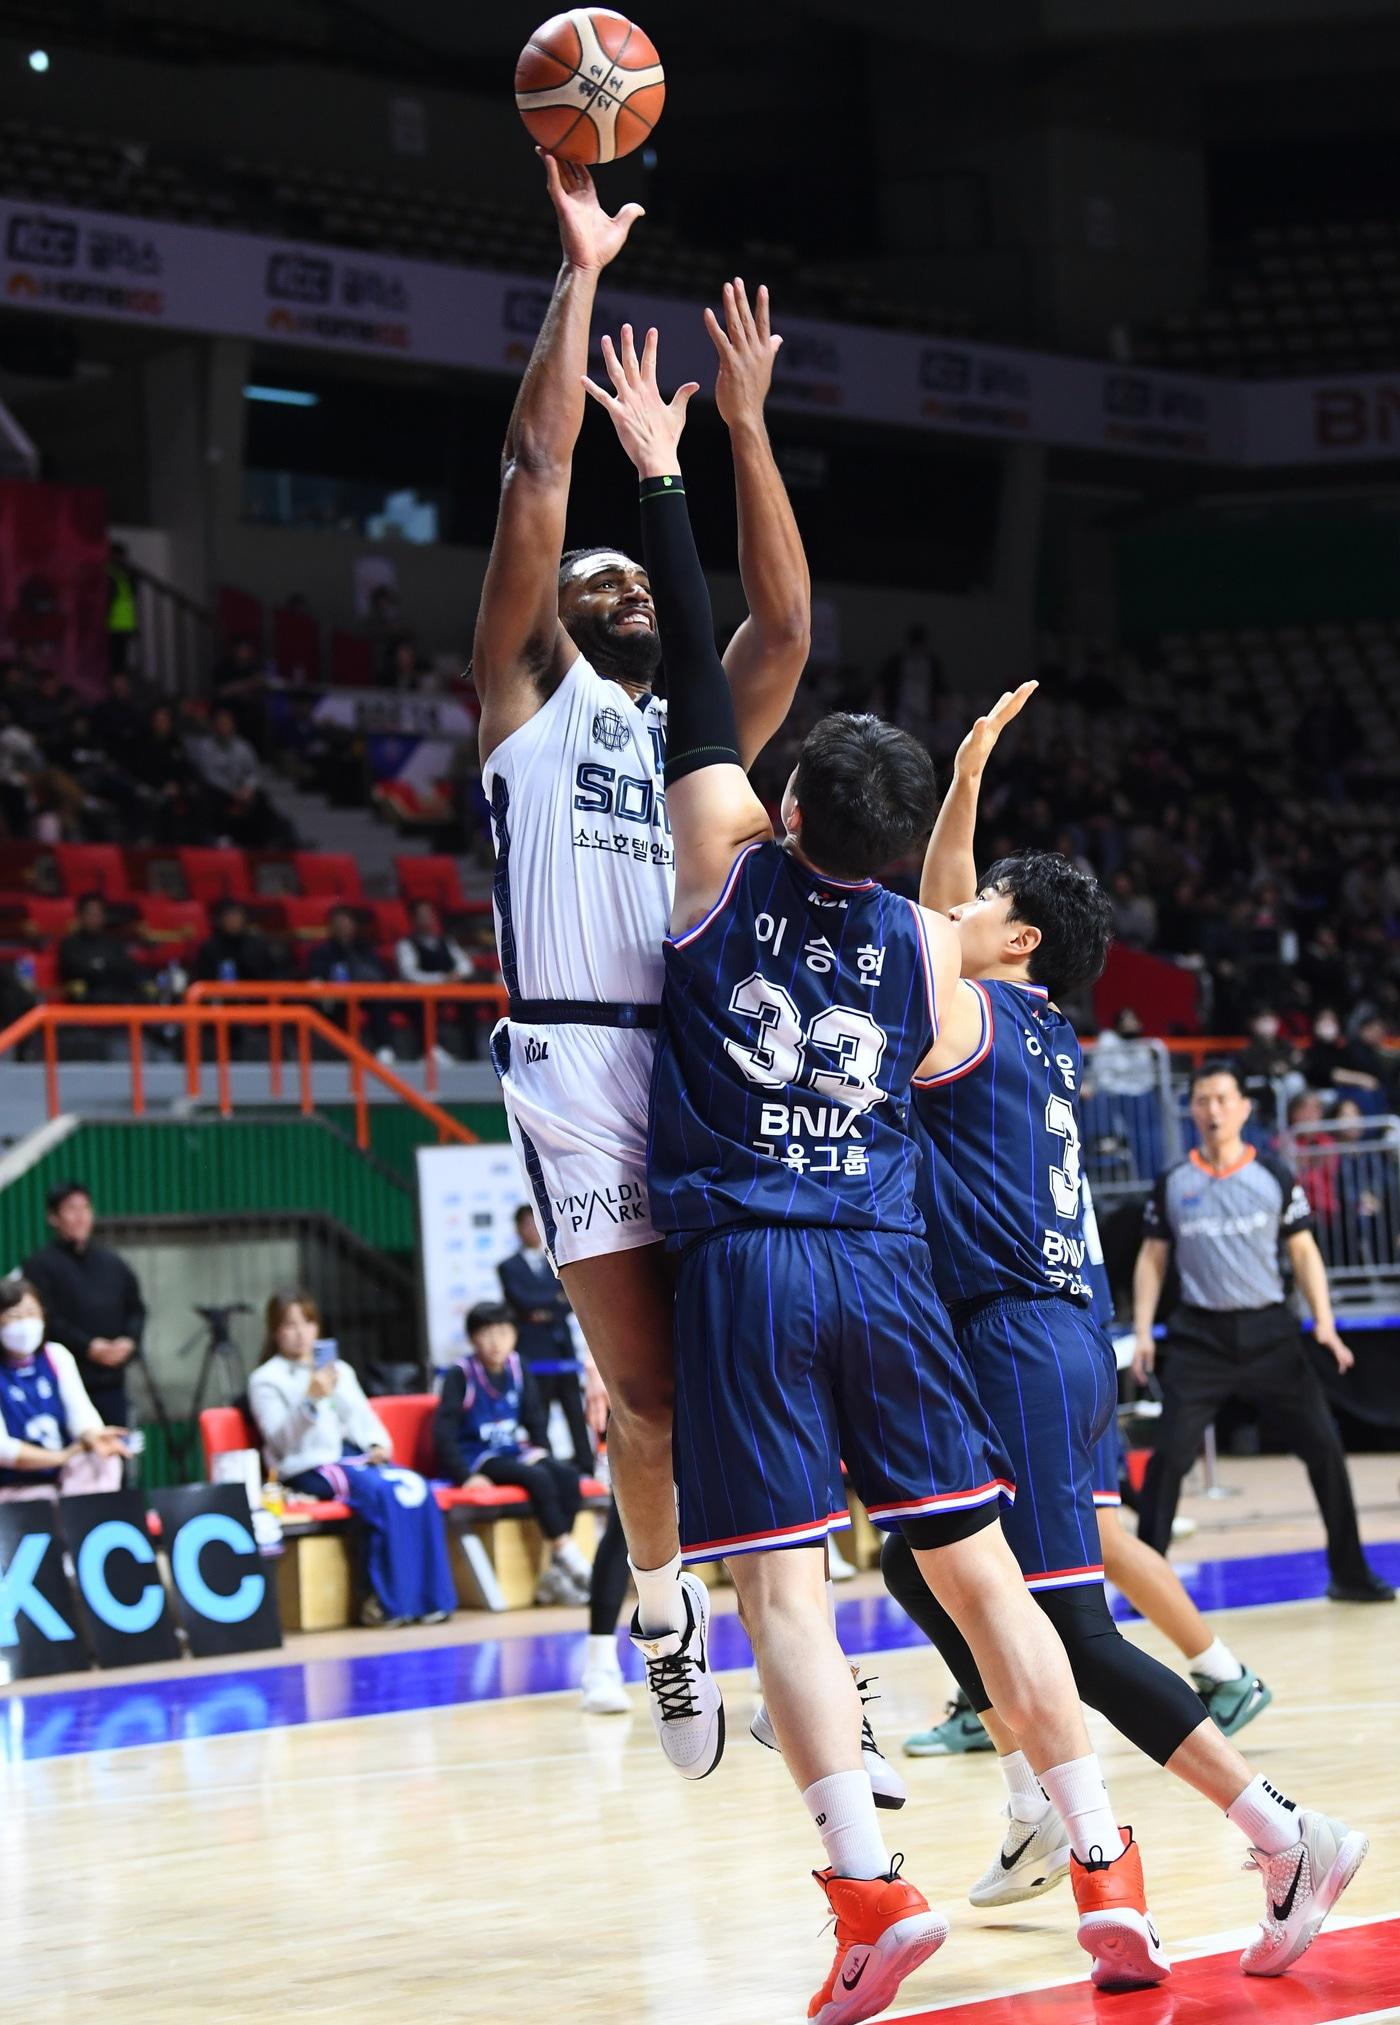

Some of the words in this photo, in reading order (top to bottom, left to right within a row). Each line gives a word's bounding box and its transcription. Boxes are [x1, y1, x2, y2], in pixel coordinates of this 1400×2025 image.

[754, 912, 887, 987] 이승현
[723, 971, 888, 1115] 33
[760, 1103, 863, 1139] BNK
[1045, 1093, 1081, 1220] 3
[556, 1182, 642, 1227] VIVALDI
[571, 1197, 646, 1233] PARK
[0, 1513, 266, 1648] KCC
